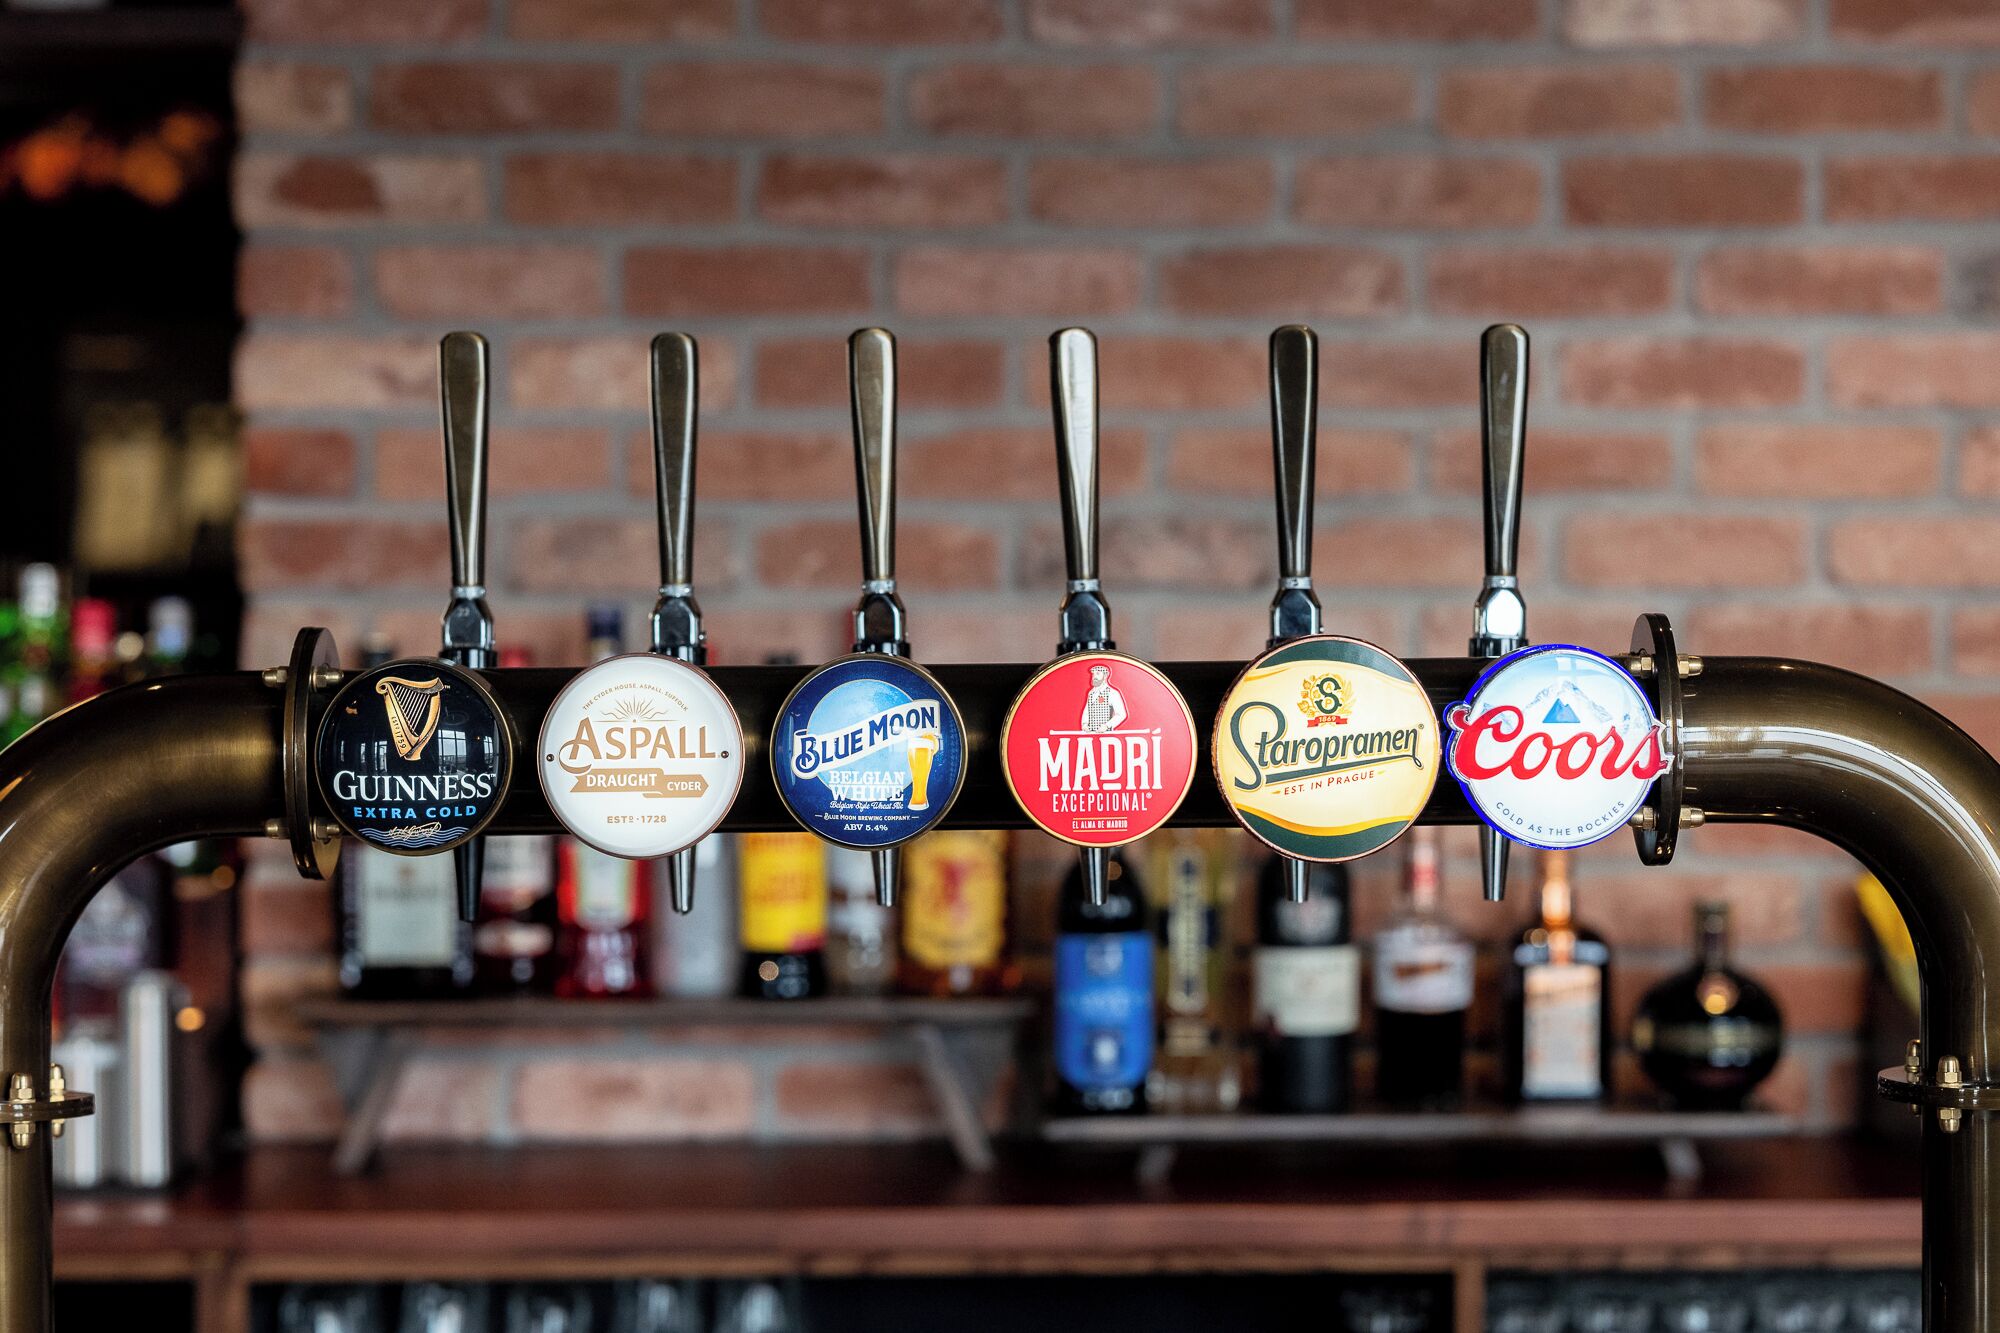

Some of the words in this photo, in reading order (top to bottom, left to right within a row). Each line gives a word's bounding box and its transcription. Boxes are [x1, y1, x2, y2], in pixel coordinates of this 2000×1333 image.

[582, 699, 594, 711] THE
[593, 688, 613, 701] CYDER
[664, 691, 689, 712] SUFFOLK
[559, 717, 716, 774] ASPALL
[795, 728, 863, 773] BLUE
[868, 706, 934, 747] MOON
[1230, 701, 1423, 790] Staropramen
[1452, 705, 1668, 780] Coors
[1037, 727, 1163, 791] MADRÍ
[333, 770, 492, 801] GUINNESS
[586, 773, 658, 788] DRAUGHT
[666, 781, 702, 791] CYDER
[828, 770, 906, 785] BELGIAN
[1284, 783, 1305, 795] EST.
[1310, 781, 1323, 790] IN
[1327, 770, 1375, 787] PRAGUE
[828, 784, 905, 802] WHITE
[1052, 792, 1149, 813] EXCEPCIONAL
[353, 806, 417, 819] EXTRA
[425, 805, 477, 818] COLD
[823, 812, 840, 820] BLUE
[871, 801, 892, 810] Wheat
[891, 801, 904, 810] Ale
[641, 815, 667, 824] 1728
[843, 823, 864, 831] ABV
[1072, 820, 1079, 829] EL
[1080, 820, 1096, 829] ALMA
[1097, 820, 1105, 829] DE
[1106, 820, 1128, 829] MADRID
[1496, 801, 1523, 826] COLD
[1527, 824, 1542, 834] AS
[1548, 827, 1571, 836] THE
[1577, 801, 1625, 833] ROCKIES
